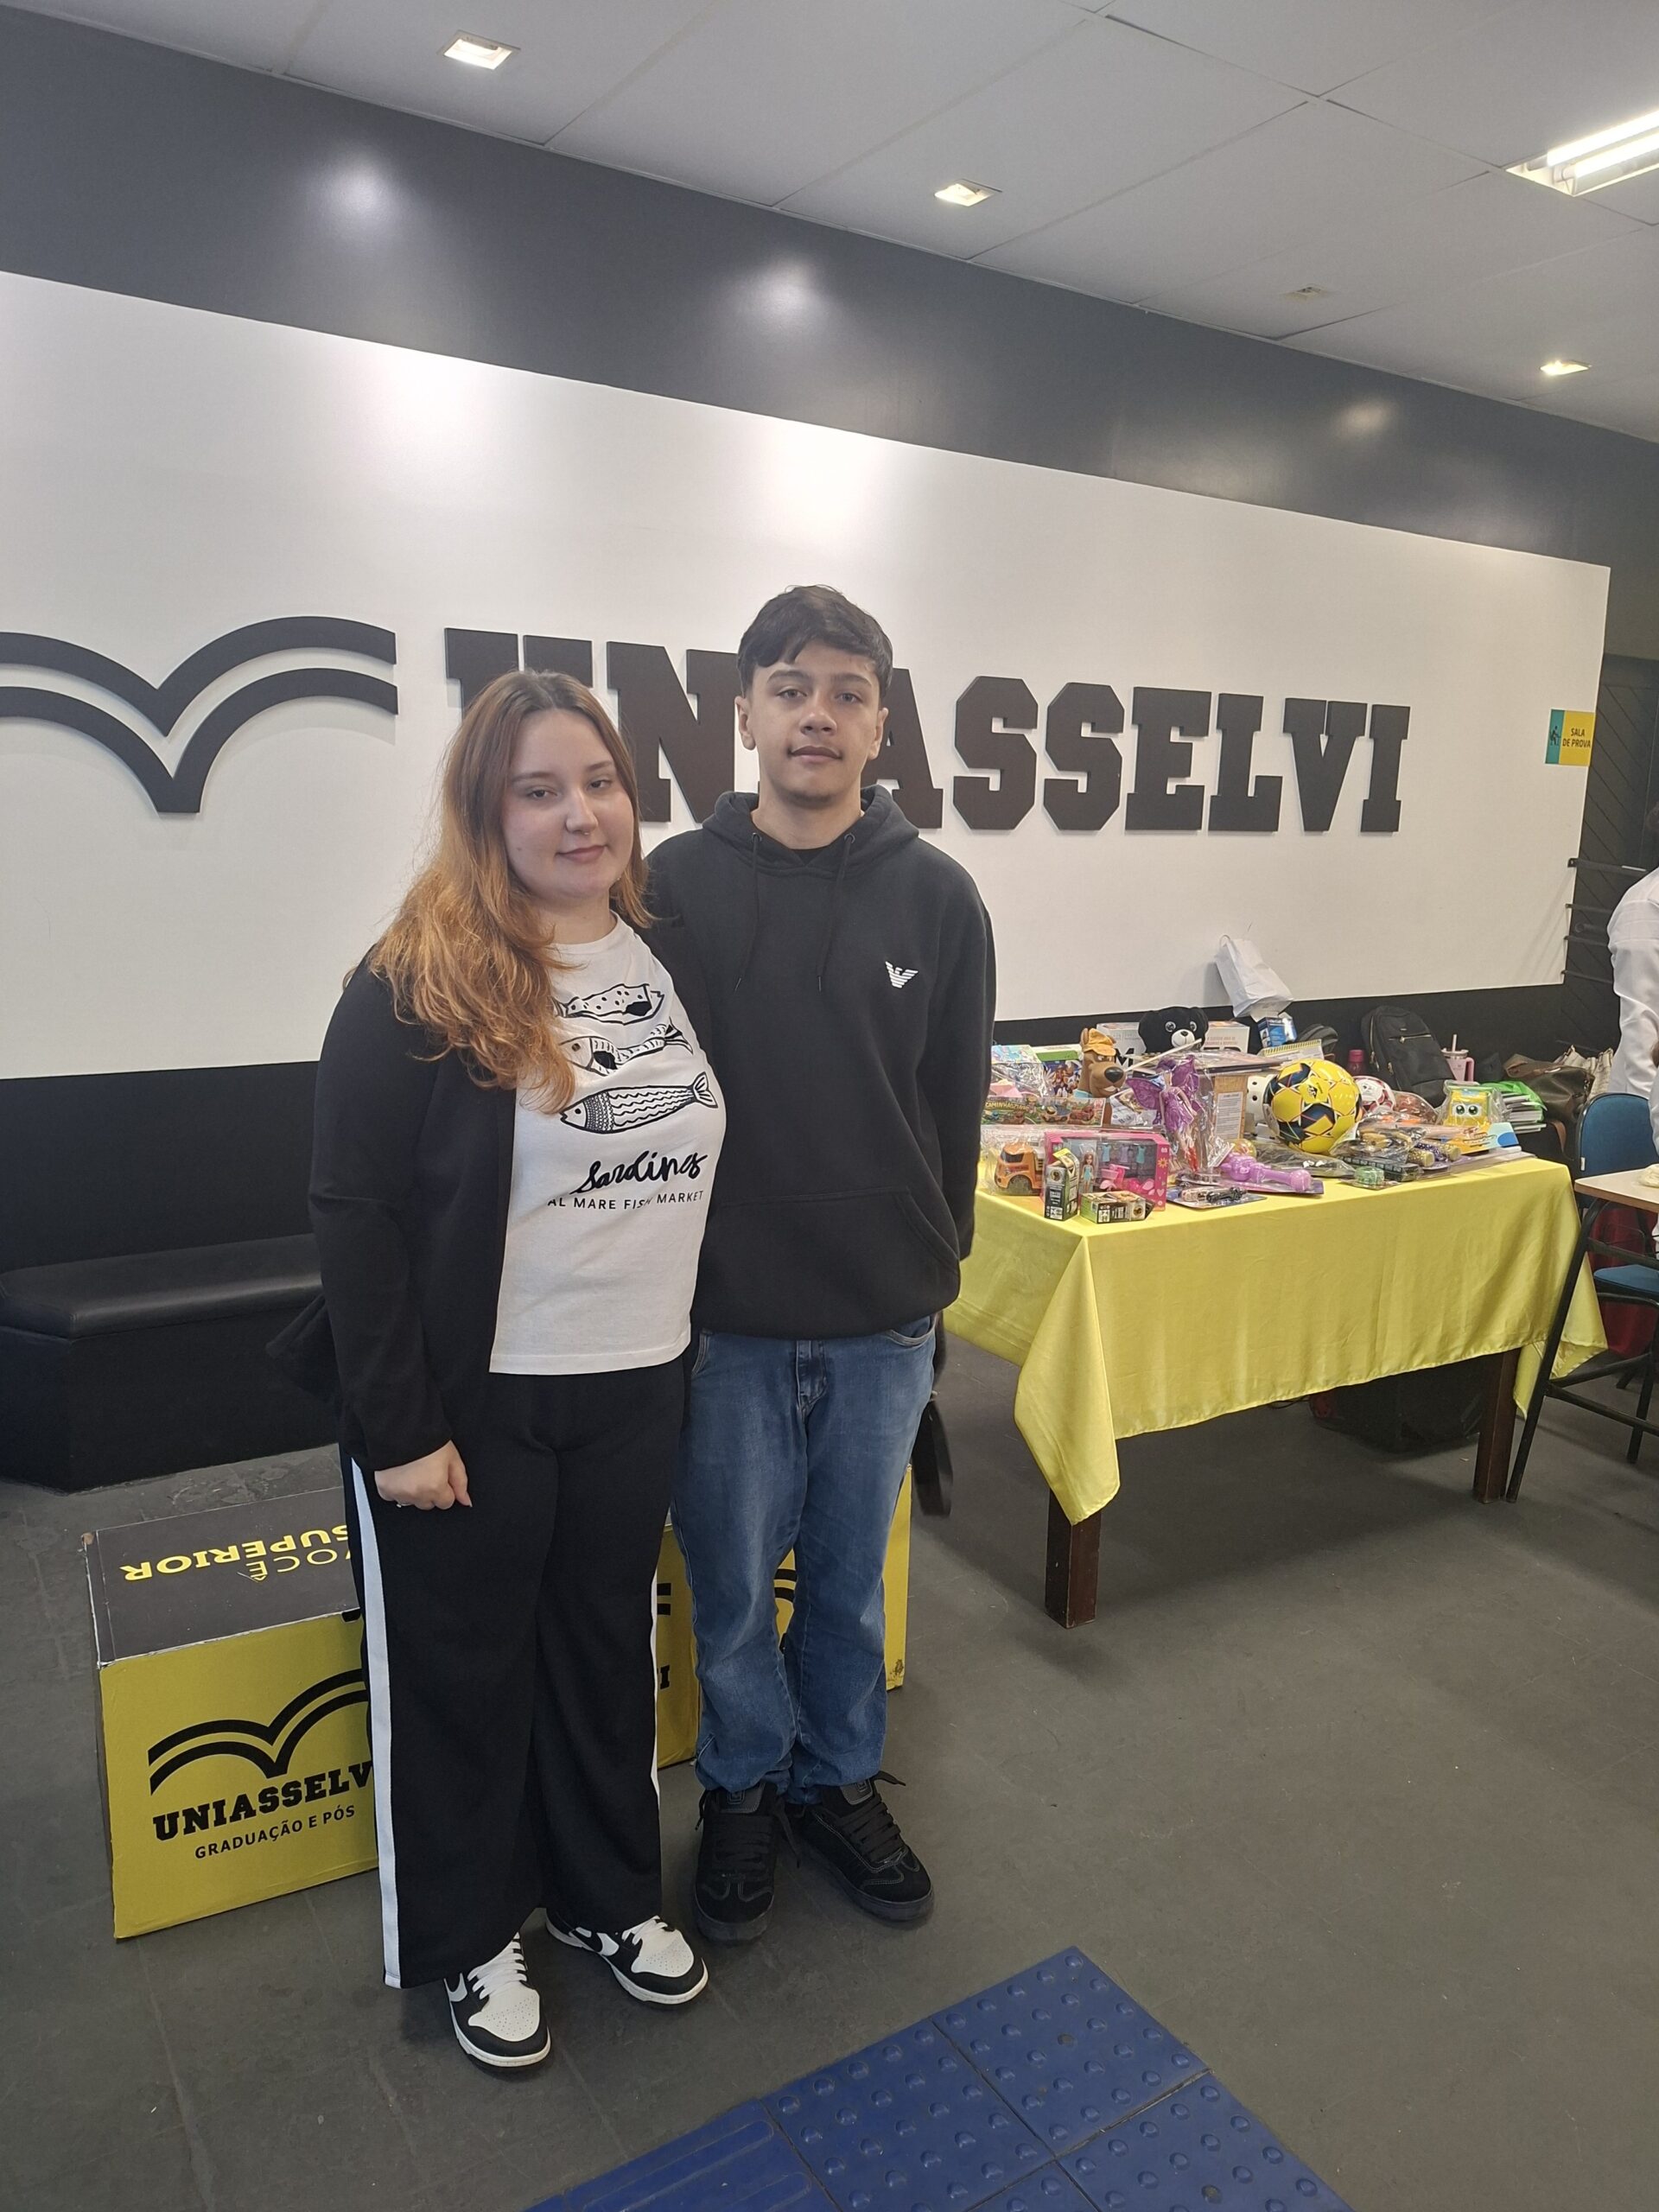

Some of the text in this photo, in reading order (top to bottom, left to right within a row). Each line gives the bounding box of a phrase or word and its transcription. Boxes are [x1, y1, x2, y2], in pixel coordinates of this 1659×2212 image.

[444, 627, 1410, 833] NASSELVI
[1562, 738, 1592, 748] DE PROVA
[1570, 728, 1586, 737] SALA
[573, 1197, 616, 1210] MARE
[656, 1190, 704, 1205] MARKET
[119, 1524, 348, 1582] SUPERIOR
[152, 1760, 374, 1842] UNIASSELV
[194, 1804, 355, 1859] GRADUAÇÃO E PÓS
